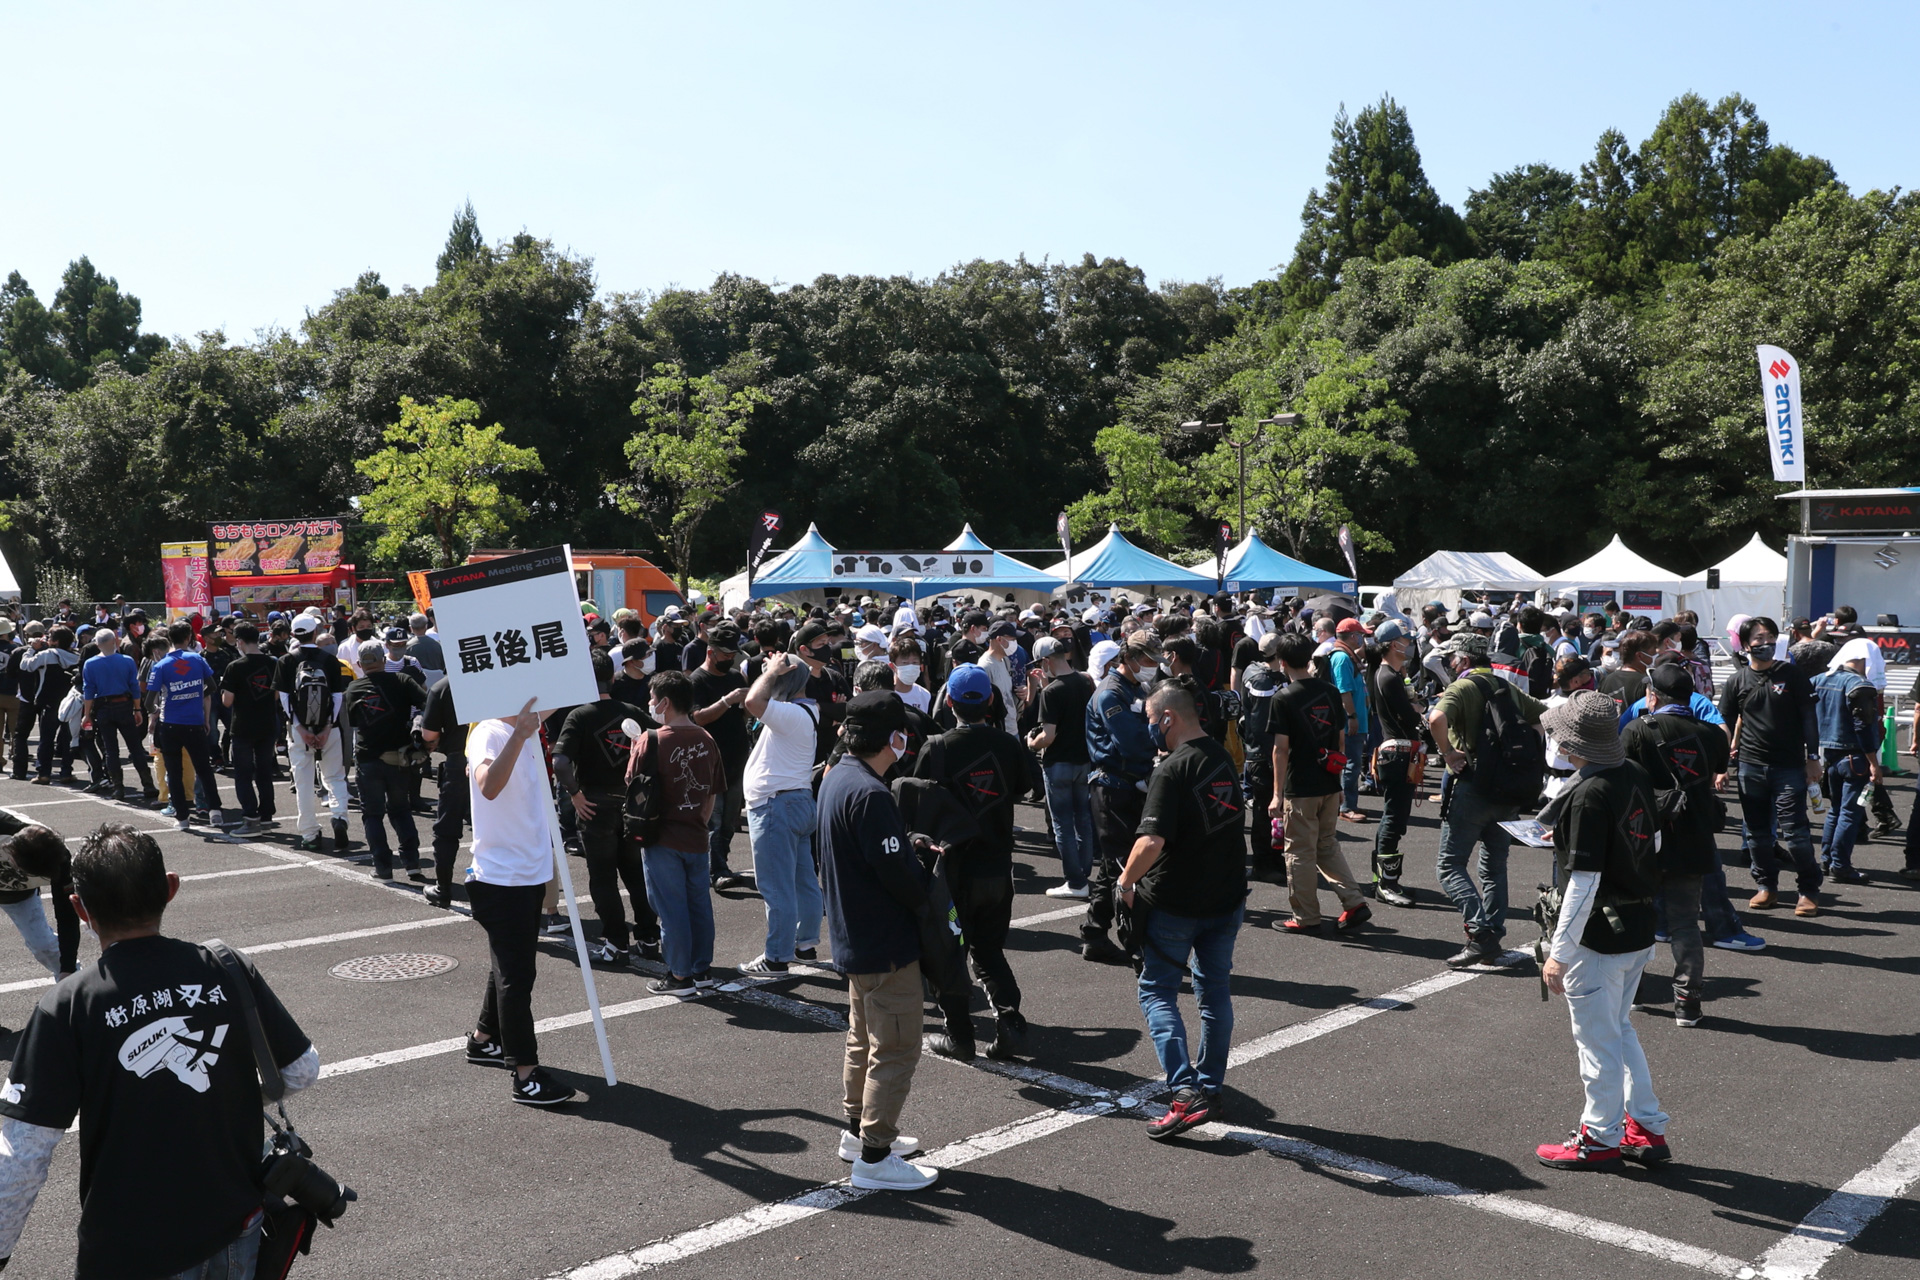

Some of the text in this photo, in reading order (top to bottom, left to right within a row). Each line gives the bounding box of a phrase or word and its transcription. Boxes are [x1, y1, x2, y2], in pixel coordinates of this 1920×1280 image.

[1840, 506, 1912, 516] KATANA
[212, 520, 342, 539] もちもちロングポテト
[442, 571, 487, 586] KATANA
[488, 562, 534, 578] Meeting
[534, 555, 562, 568] 2019
[458, 620, 568, 674] 最後尾
[170, 678, 202, 692] SUZUKI
[881, 836, 900, 854] 19
[127, 1027, 168, 1062] SUZUKI
